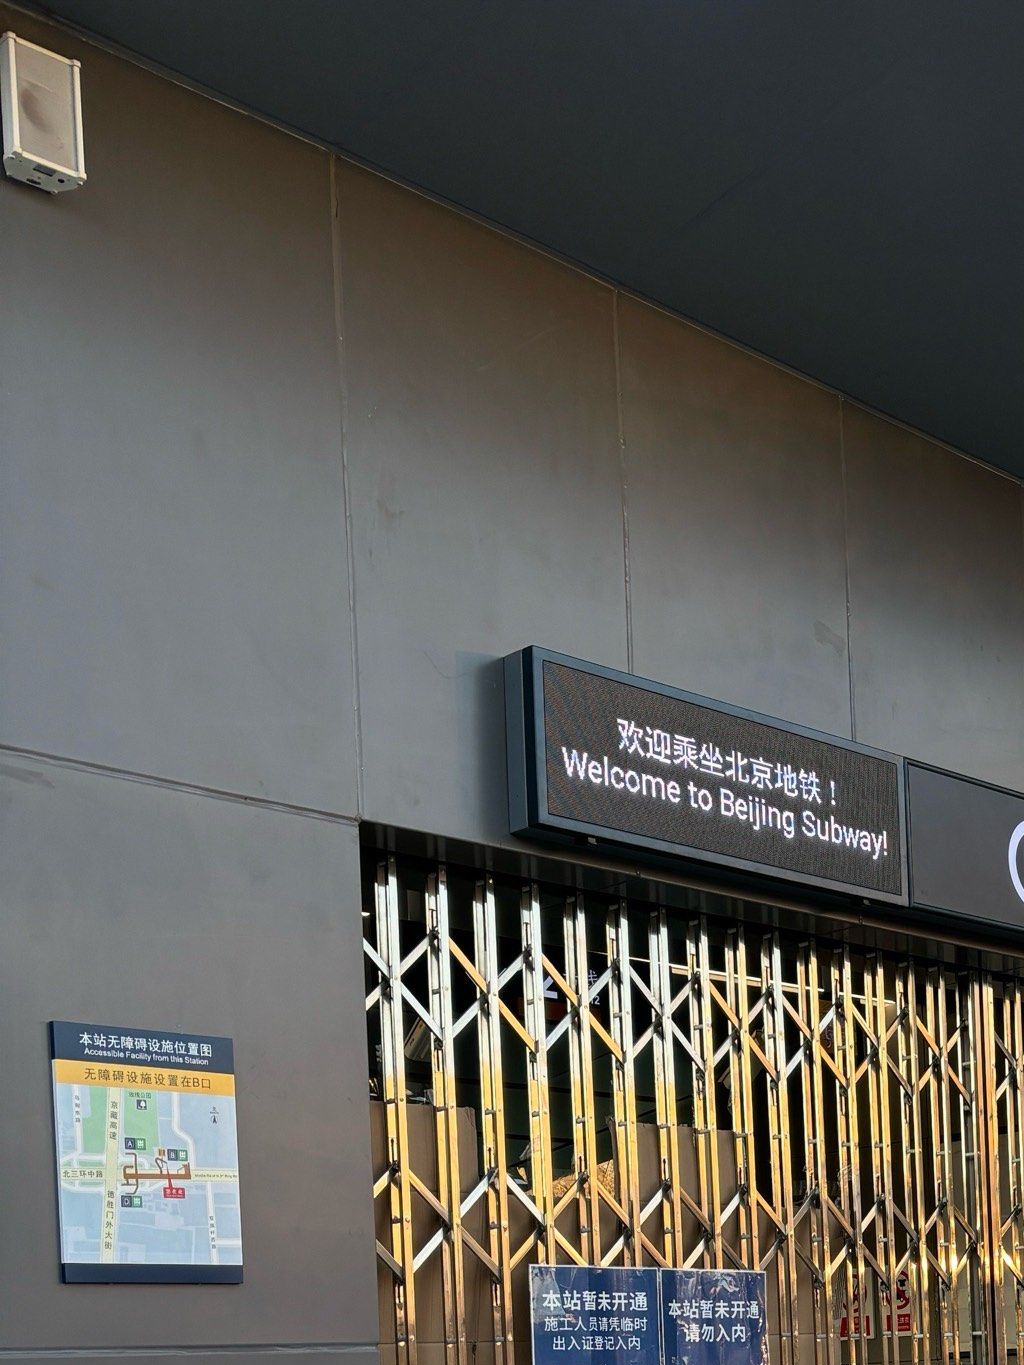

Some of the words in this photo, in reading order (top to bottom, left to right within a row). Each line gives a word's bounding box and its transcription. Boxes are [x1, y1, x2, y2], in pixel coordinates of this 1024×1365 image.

[616, 718, 837, 806] 欢迎乘坐北京地铁！
[562, 746, 681, 802] Welcome
[688, 782, 713, 811] to
[720, 788, 796, 839] Beijing
[802, 810, 888, 860] Subway!
[79, 1032, 212, 1057] 本站无障碍设施位置图
[84, 1047, 124, 1058] Accessible
[125, 1051, 151, 1062] Facility
[153, 1053, 169, 1062] from
[170, 1055, 183, 1063] this
[185, 1056, 208, 1065] Station
[84, 1067, 211, 1089] 无障碍设施设置在B口
[542, 1290, 648, 1312] 本站暂未开通
[668, 1300, 760, 1320] 本站暂未开通
[544, 1316, 648, 1332] 施工人员请凭临时
[684, 1323, 746, 1343] 请勿入内
[552, 1335, 641, 1351] 出入证登记入内
